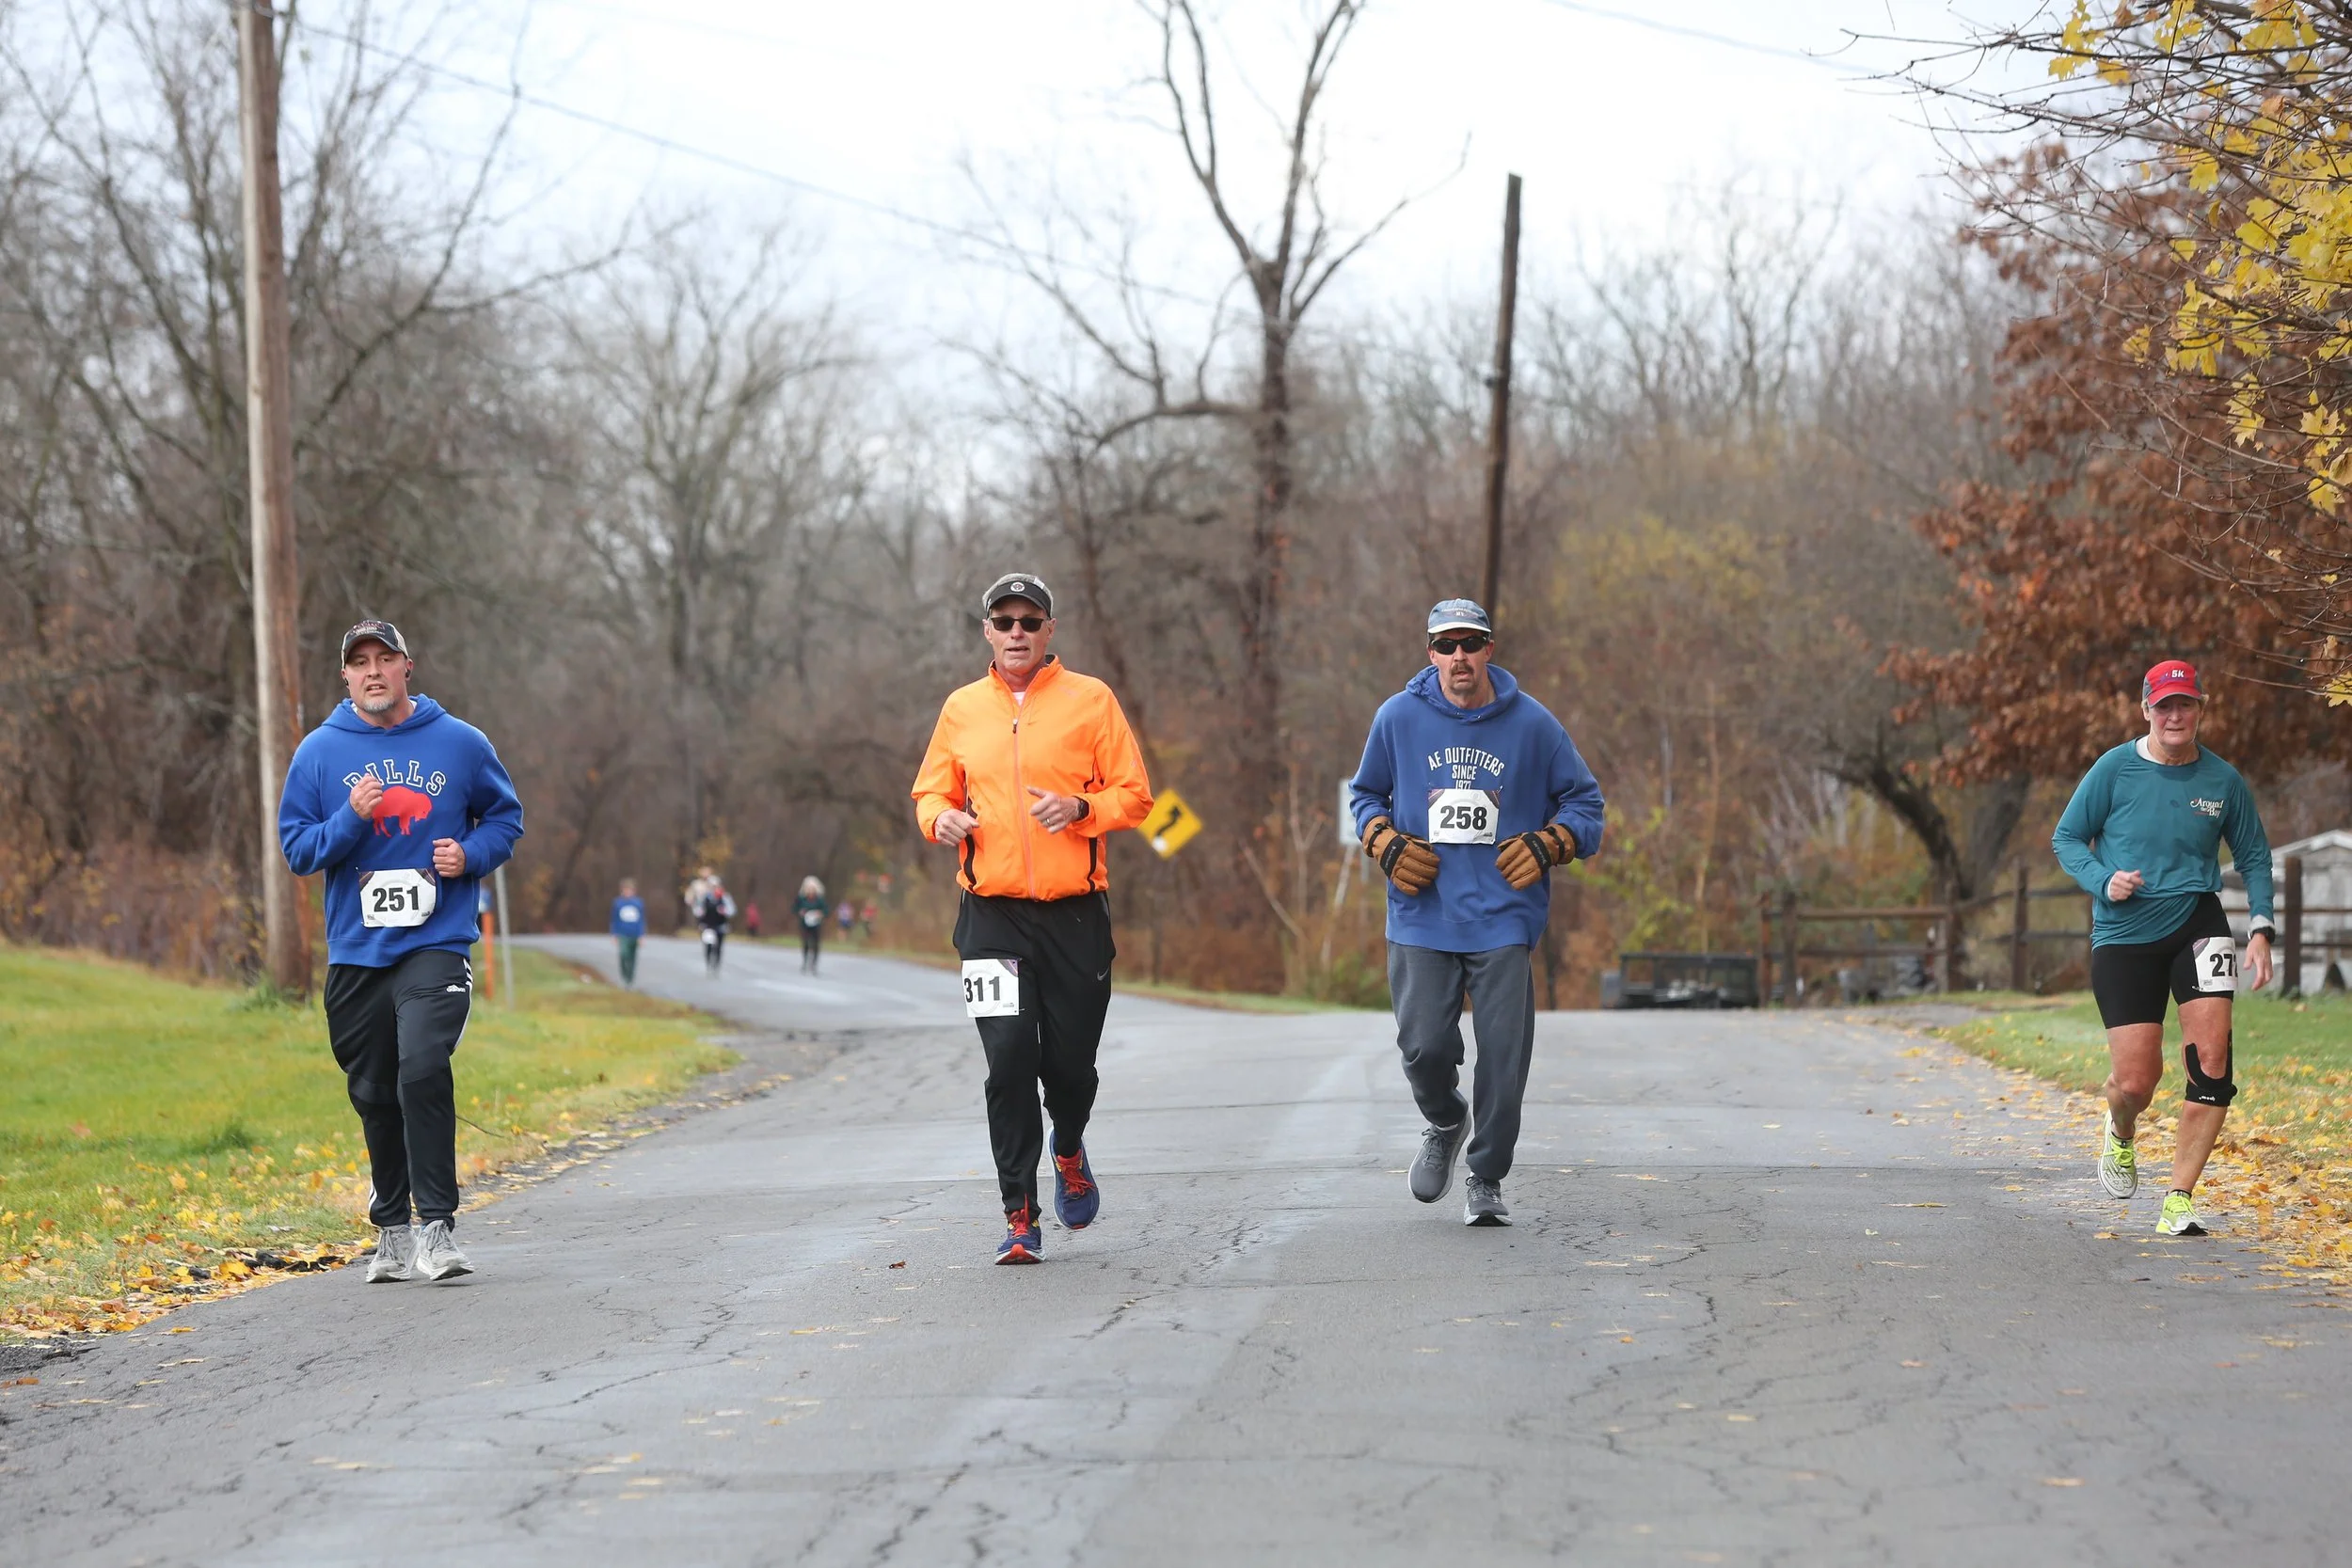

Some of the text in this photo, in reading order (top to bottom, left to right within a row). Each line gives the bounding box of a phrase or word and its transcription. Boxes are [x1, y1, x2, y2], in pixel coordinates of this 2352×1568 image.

[2171, 669, 2185, 678] 5K
[1427, 747, 1505, 778] AE OUTFITTERS
[1452, 764, 1478, 780] SINCE
[2190, 798, 2224, 809] Around
[1439, 805, 1487, 831] 258
[372, 885, 420, 912] 251
[964, 976, 1001, 1004] 311
